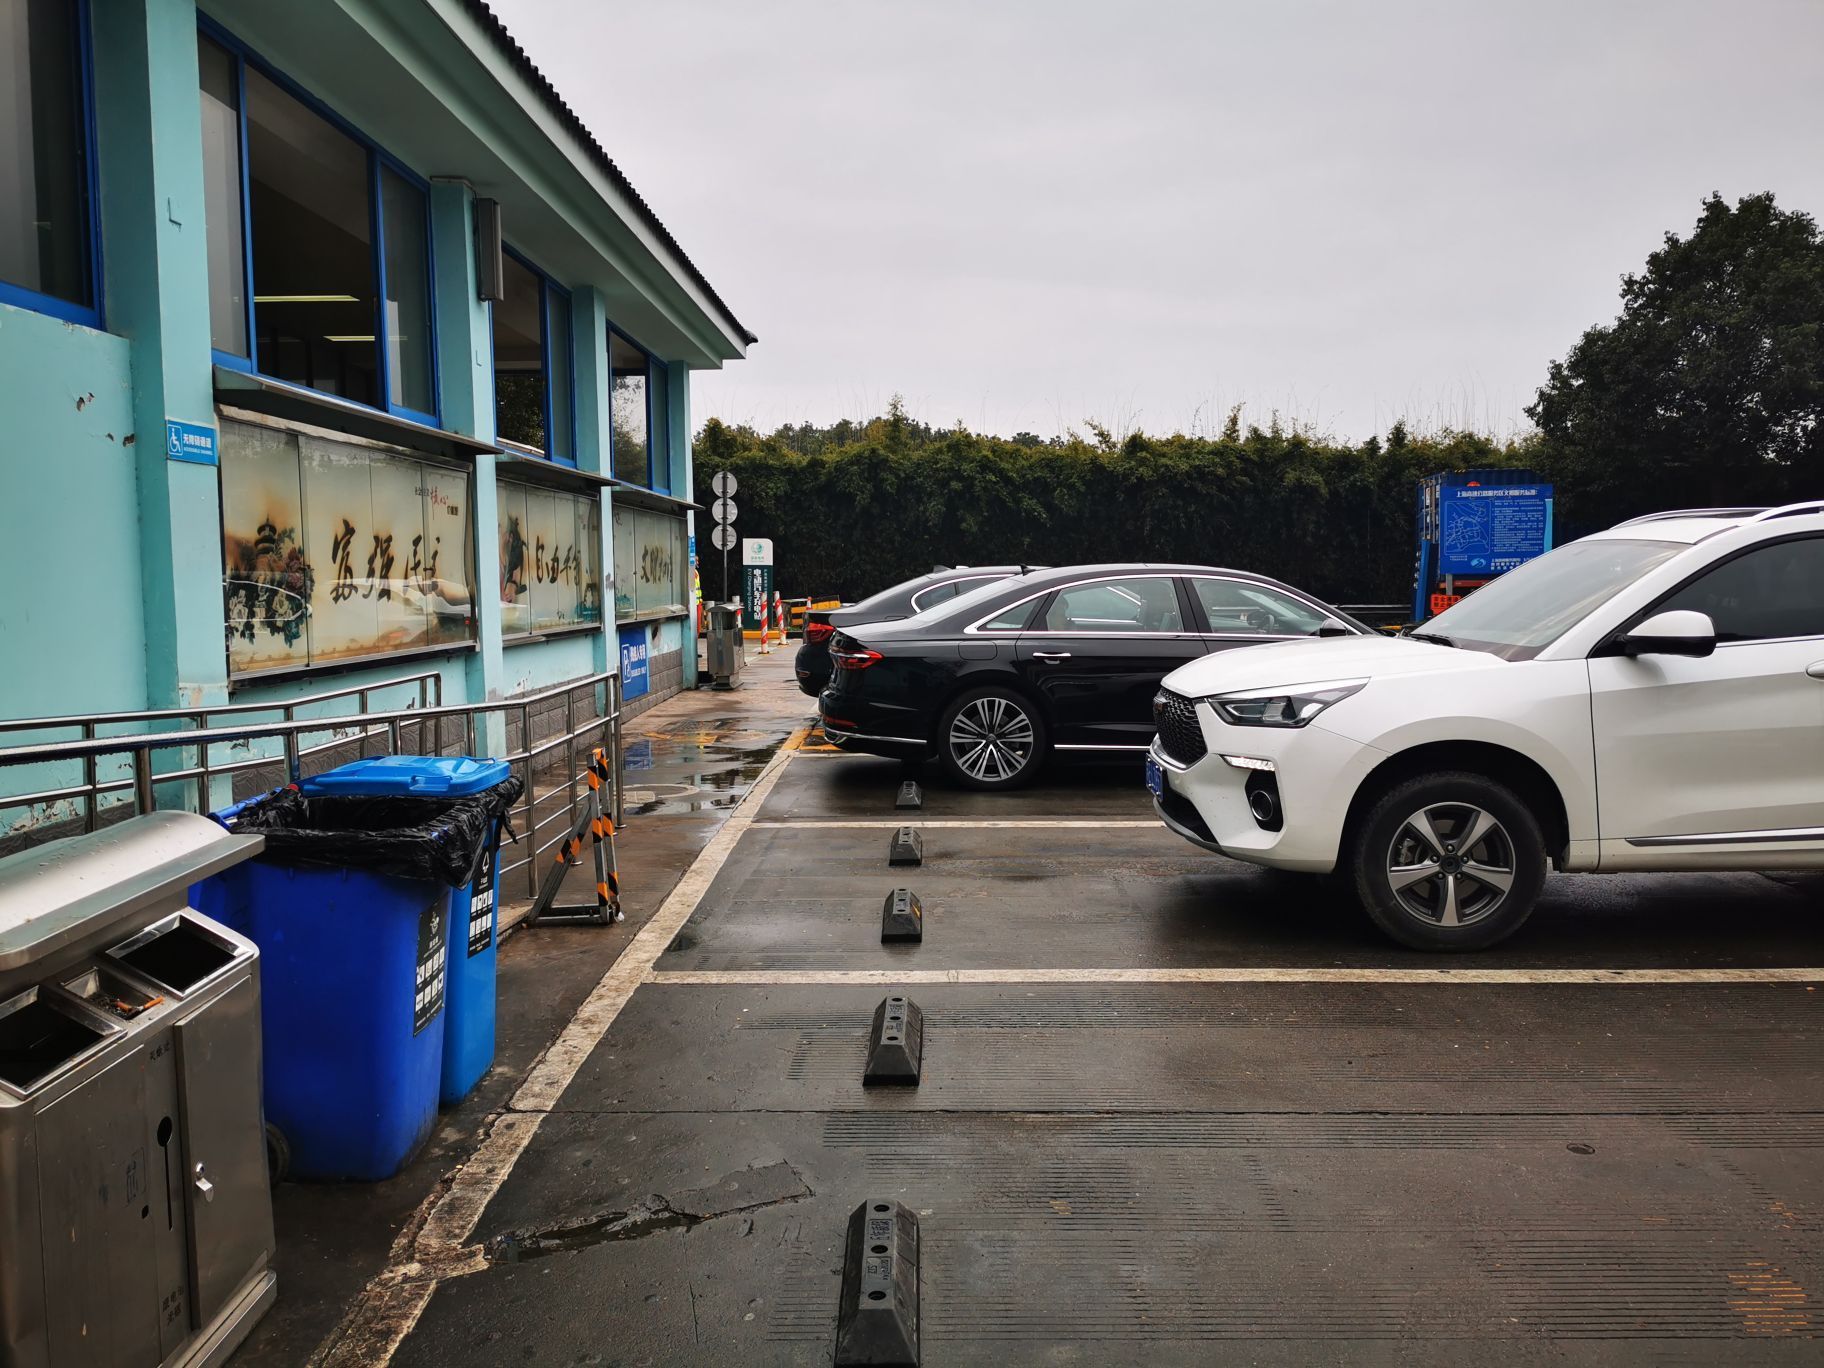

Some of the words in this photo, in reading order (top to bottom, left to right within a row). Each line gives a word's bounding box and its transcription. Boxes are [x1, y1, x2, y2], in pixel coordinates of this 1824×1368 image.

[183, 433, 212, 449] 无障碍通道
